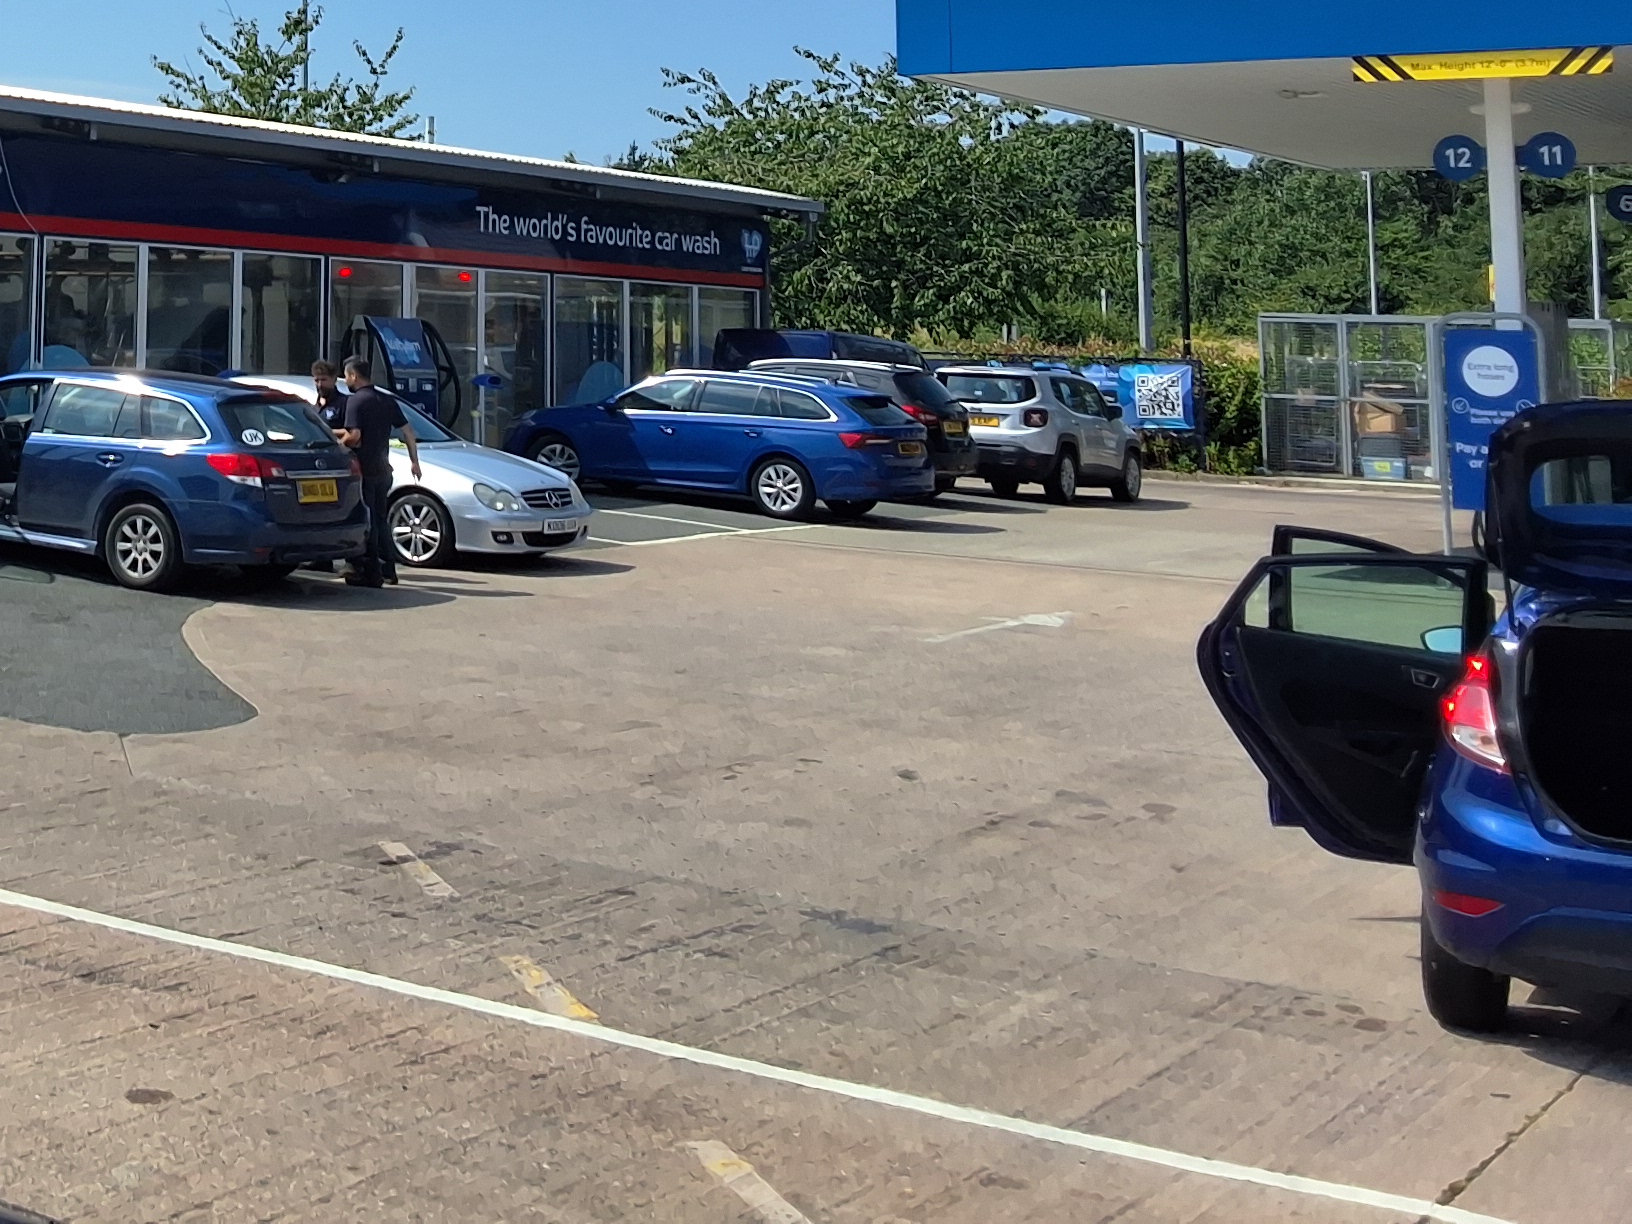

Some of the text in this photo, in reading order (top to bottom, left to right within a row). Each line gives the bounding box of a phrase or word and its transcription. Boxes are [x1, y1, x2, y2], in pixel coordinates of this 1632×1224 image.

[1439, 61, 1475, 72] Height
[1444, 147, 1472, 169] 12
[1538, 144, 1563, 166] 11
[475, 205, 720, 256] The world's favourite car wash
[244, 432, 263, 443] UK
[1455, 442, 1478, 457] Pay
[1469, 459, 1484, 469] or
